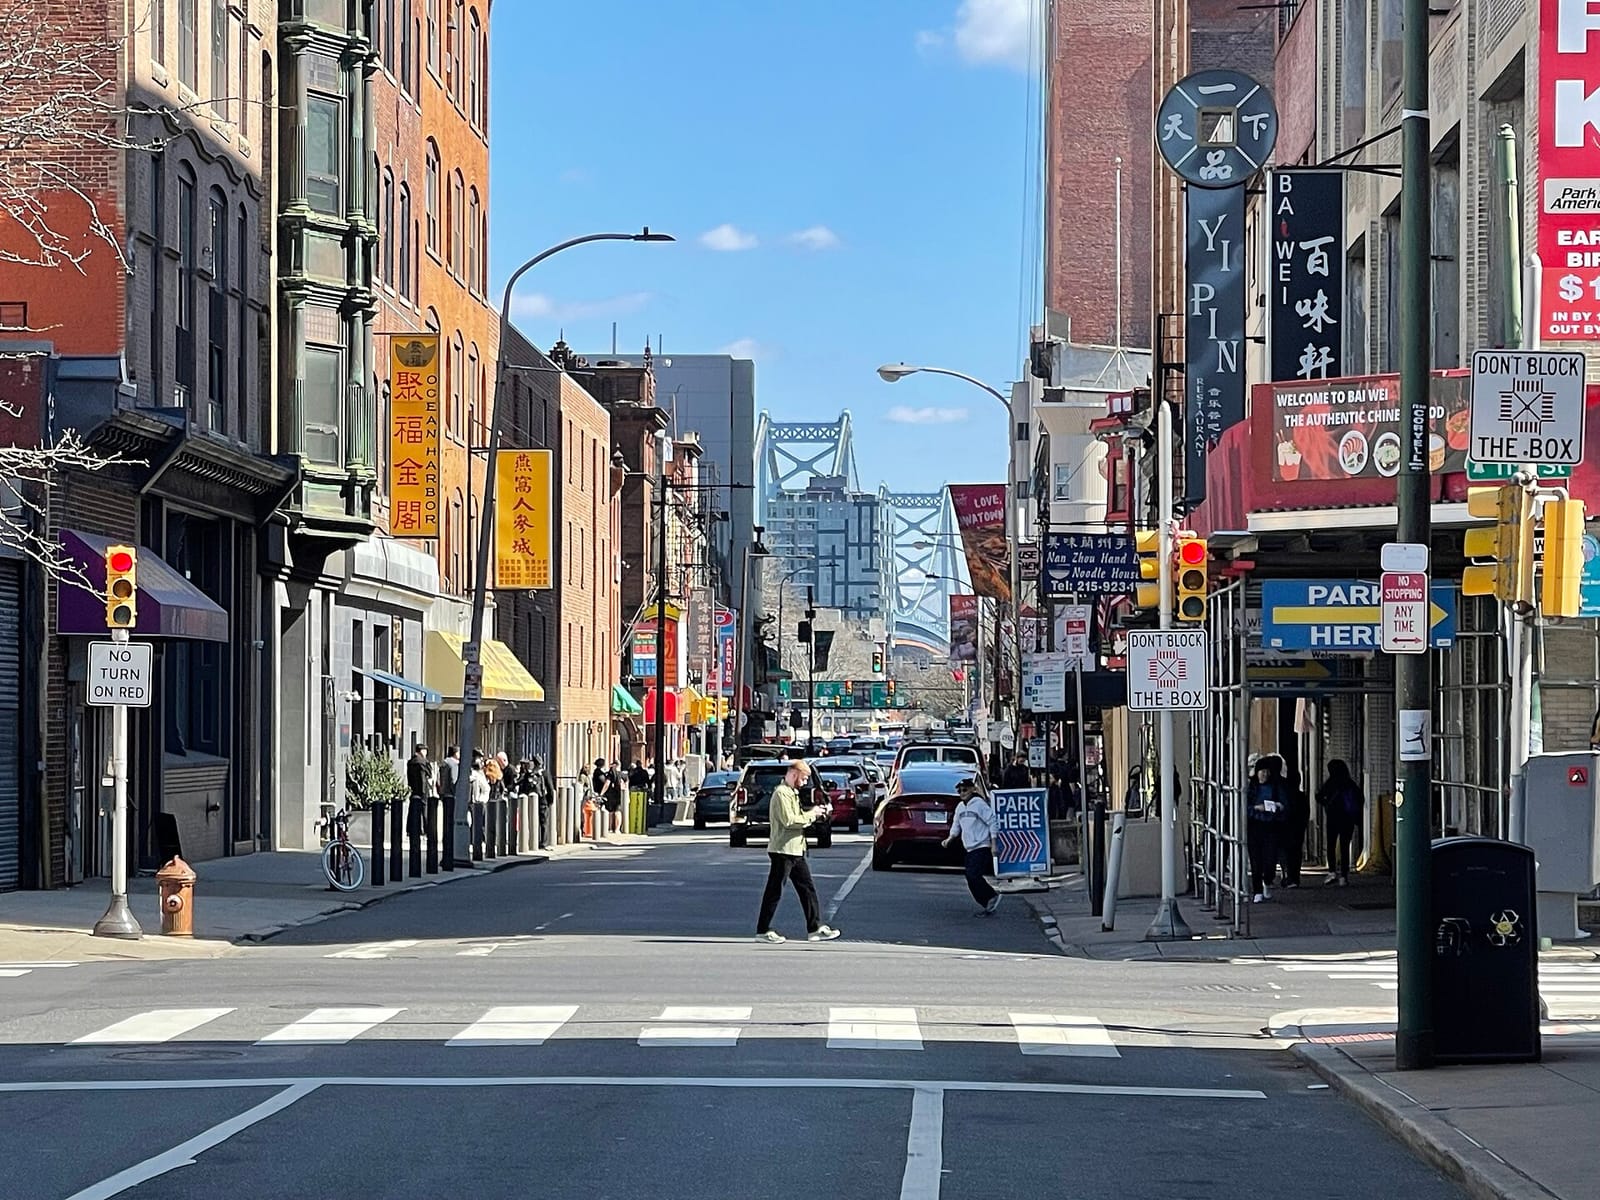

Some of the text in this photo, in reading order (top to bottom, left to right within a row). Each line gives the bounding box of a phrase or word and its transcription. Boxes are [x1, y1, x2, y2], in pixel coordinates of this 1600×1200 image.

[1561, 187, 1597, 199] Park
[1276, 241, 1295, 305] WEI
[1552, 311, 1568, 322] IN
[1572, 311, 1592, 322] BY
[1549, 324, 1580, 335] OUT
[1527, 356, 1579, 376] BLOCK
[1277, 388, 1389, 407] WELCOME TO BAI WEI
[1284, 413, 1304, 428] THE
[1305, 410, 1366, 426] AUTHENTIC
[1367, 408, 1401, 423] CHINE
[425, 374, 437, 524] OCEAN HARBOR
[1478, 436, 1574, 460] THE BOX
[1046, 551, 1067, 564] Nan
[1071, 551, 1096, 564] Zhou
[1100, 552, 1128, 565] Hand
[1071, 566, 1107, 579] Noodle
[1050, 580, 1073, 591] Tel:
[1397, 575, 1410, 587] NO
[1385, 588, 1423, 600] STOPPING
[1394, 605, 1414, 618] ANY
[1394, 620, 1415, 632] TIME
[1167, 633, 1203, 648] BLOCK
[109, 650, 132, 662] NO
[100, 667, 140, 681] TURN
[94, 685, 145, 699] ON RED
[1134, 690, 1203, 707] THE BOX
[996, 796, 1041, 812] PARK
[996, 812, 1041, 829] HERE
